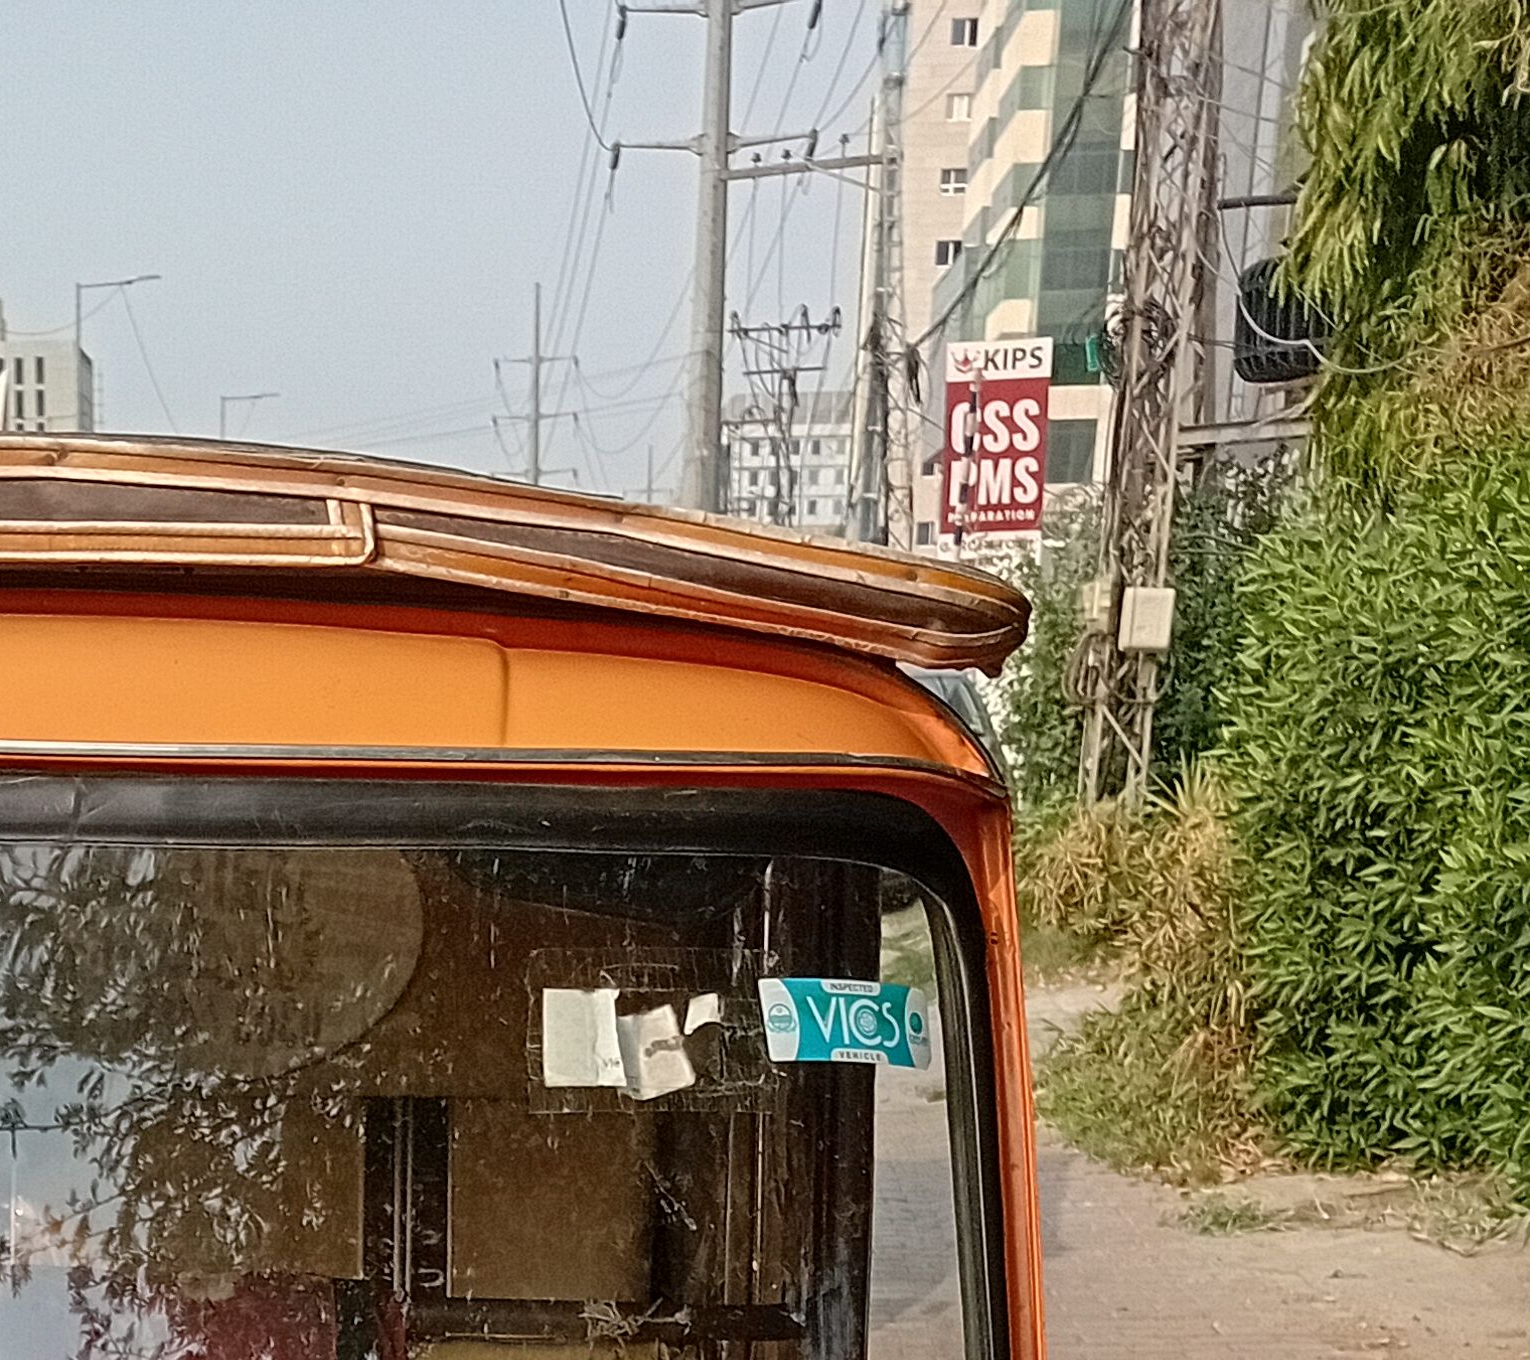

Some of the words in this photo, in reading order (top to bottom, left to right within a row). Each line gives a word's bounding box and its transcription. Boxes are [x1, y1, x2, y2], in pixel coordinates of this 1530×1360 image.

[984, 346, 1043, 371] KIPS
[951, 398, 1040, 454] CSS
[949, 457, 1039, 506] PMS
[829, 982, 874, 993] INSPECTED
[806, 996, 900, 1048] VICS
[839, 1051, 881, 1062] VEHICLE
